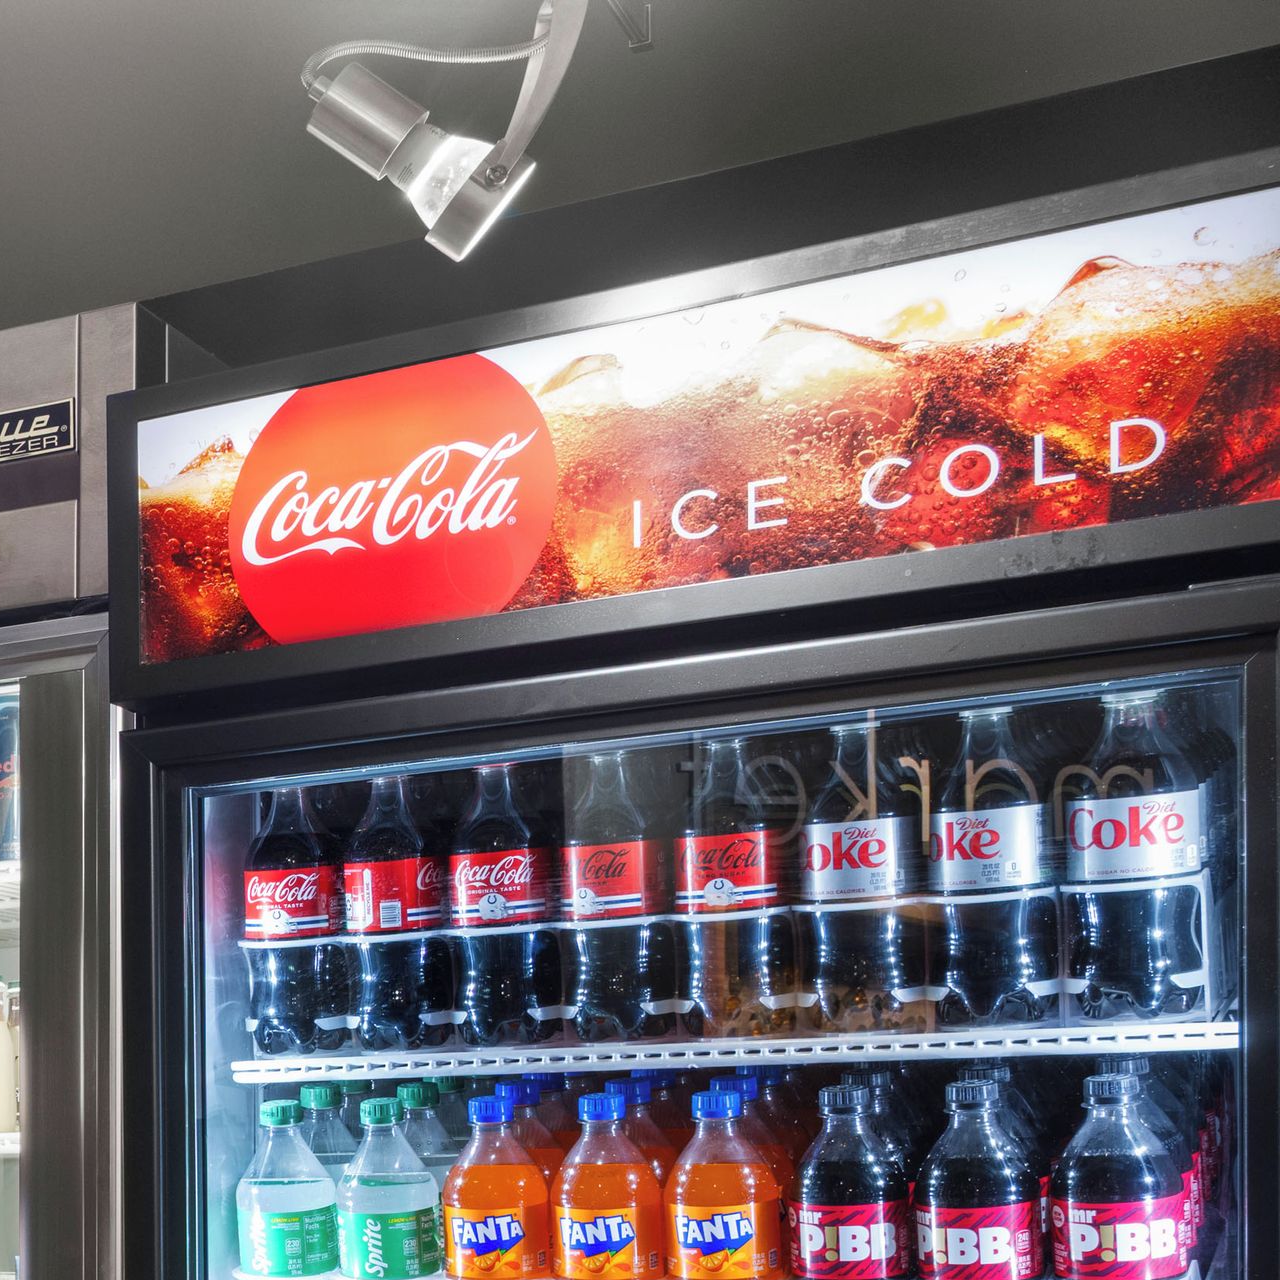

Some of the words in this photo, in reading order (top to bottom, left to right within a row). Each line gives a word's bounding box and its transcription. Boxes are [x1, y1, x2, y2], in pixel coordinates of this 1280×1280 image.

[242, 427, 539, 566] Coca-Cola
[632, 474, 787, 549] ICE
[859, 417, 1167, 512] COLD
[845, 827, 877, 841] Diet
[955, 817, 989, 831] Diet
[1069, 806, 1185, 852] Coke
[929, 822, 1001, 861] oke
[455, 854, 536, 890] Coca-Cola
[247, 873, 320, 903] Coca-Cola
[502, 885, 521, 893] TASTE
[452, 1216, 523, 1244] FANTA
[561, 1215, 634, 1244] FANTA
[675, 1214, 754, 1243] FANTA
[799, 1210, 821, 1224] mr
[1069, 1208, 1096, 1223] mr
[365, 1218, 384, 1279] Sprite
